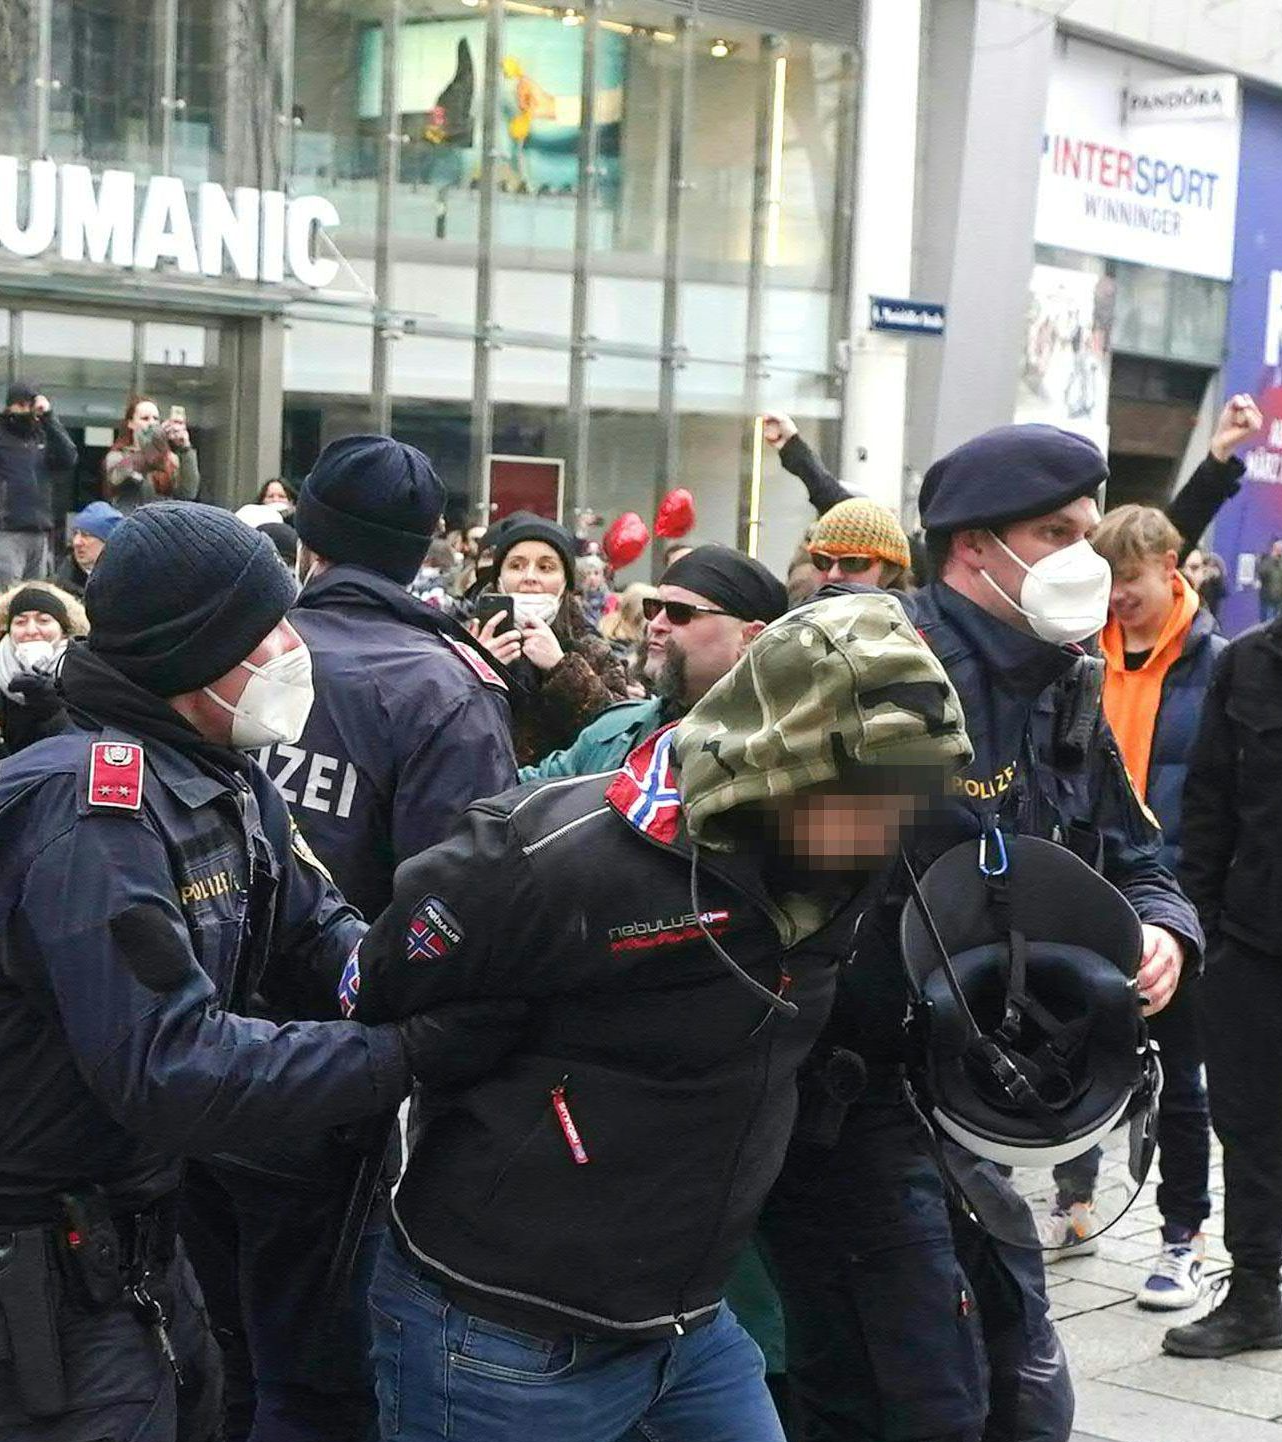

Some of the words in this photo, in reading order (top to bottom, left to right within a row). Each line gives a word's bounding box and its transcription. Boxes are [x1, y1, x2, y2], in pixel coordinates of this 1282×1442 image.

[1053, 134, 1220, 211] INTERSPORT
[1084, 193, 1182, 237] WINNINGER
[424, 905, 461, 943] nebulus
